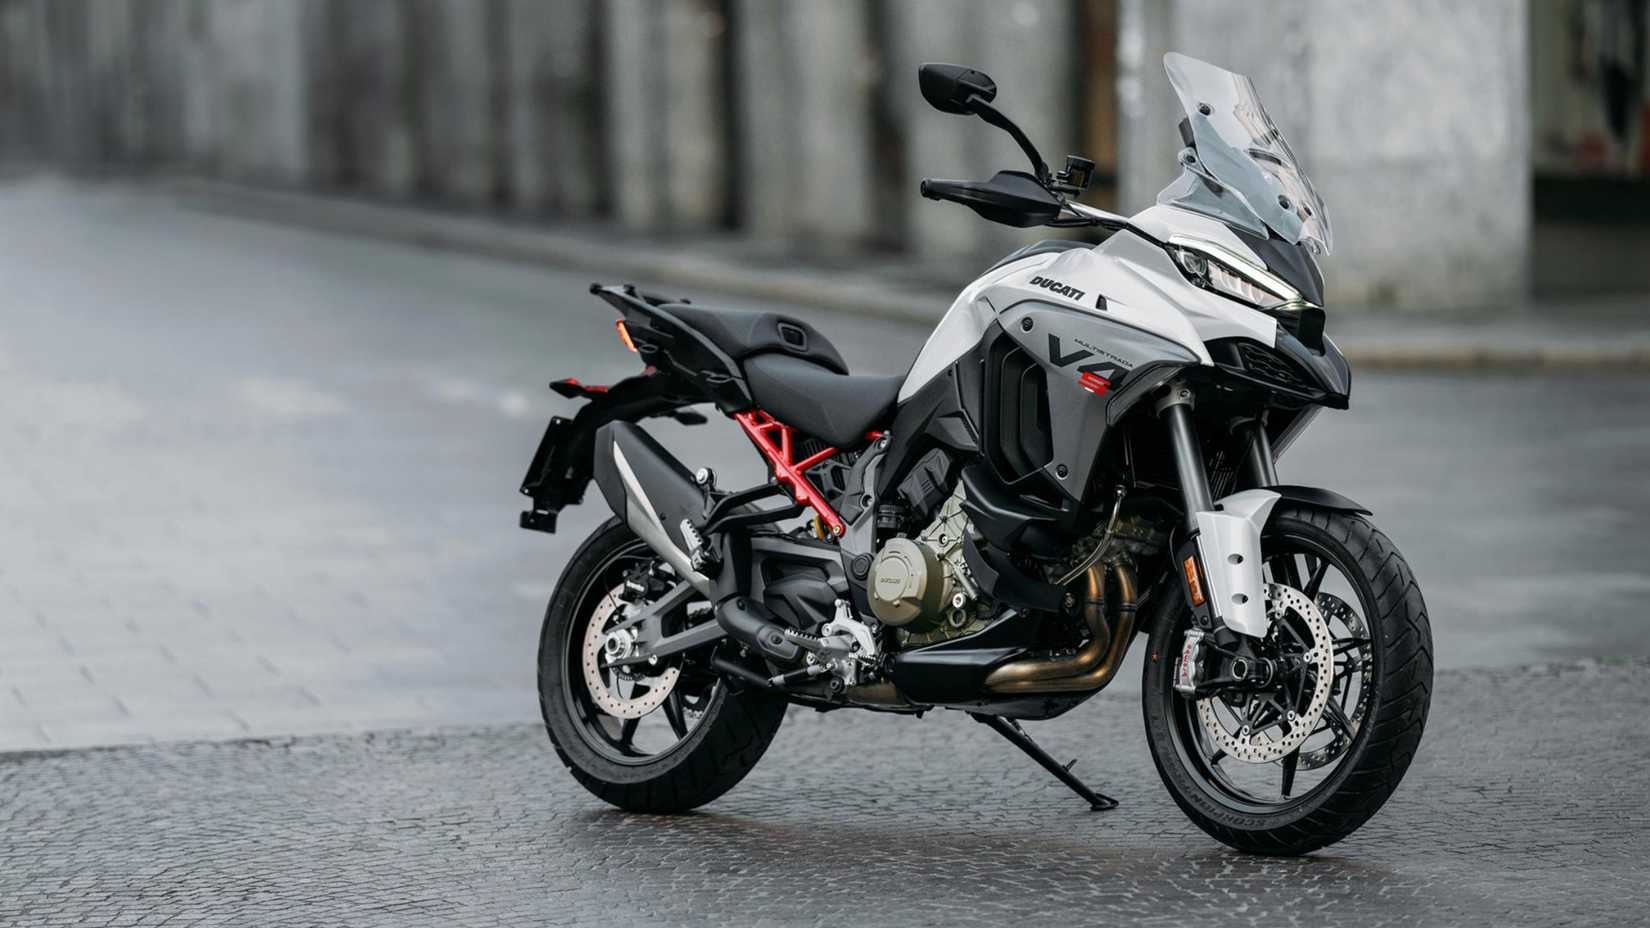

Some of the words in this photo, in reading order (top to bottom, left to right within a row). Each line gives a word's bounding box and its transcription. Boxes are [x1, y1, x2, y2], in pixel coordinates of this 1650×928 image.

[1029, 276, 1086, 301] DUCATI
[1074, 338, 1134, 368] MULTISTRADA
[1077, 370, 1112, 397] S
[1182, 644, 1192, 677] brembo
